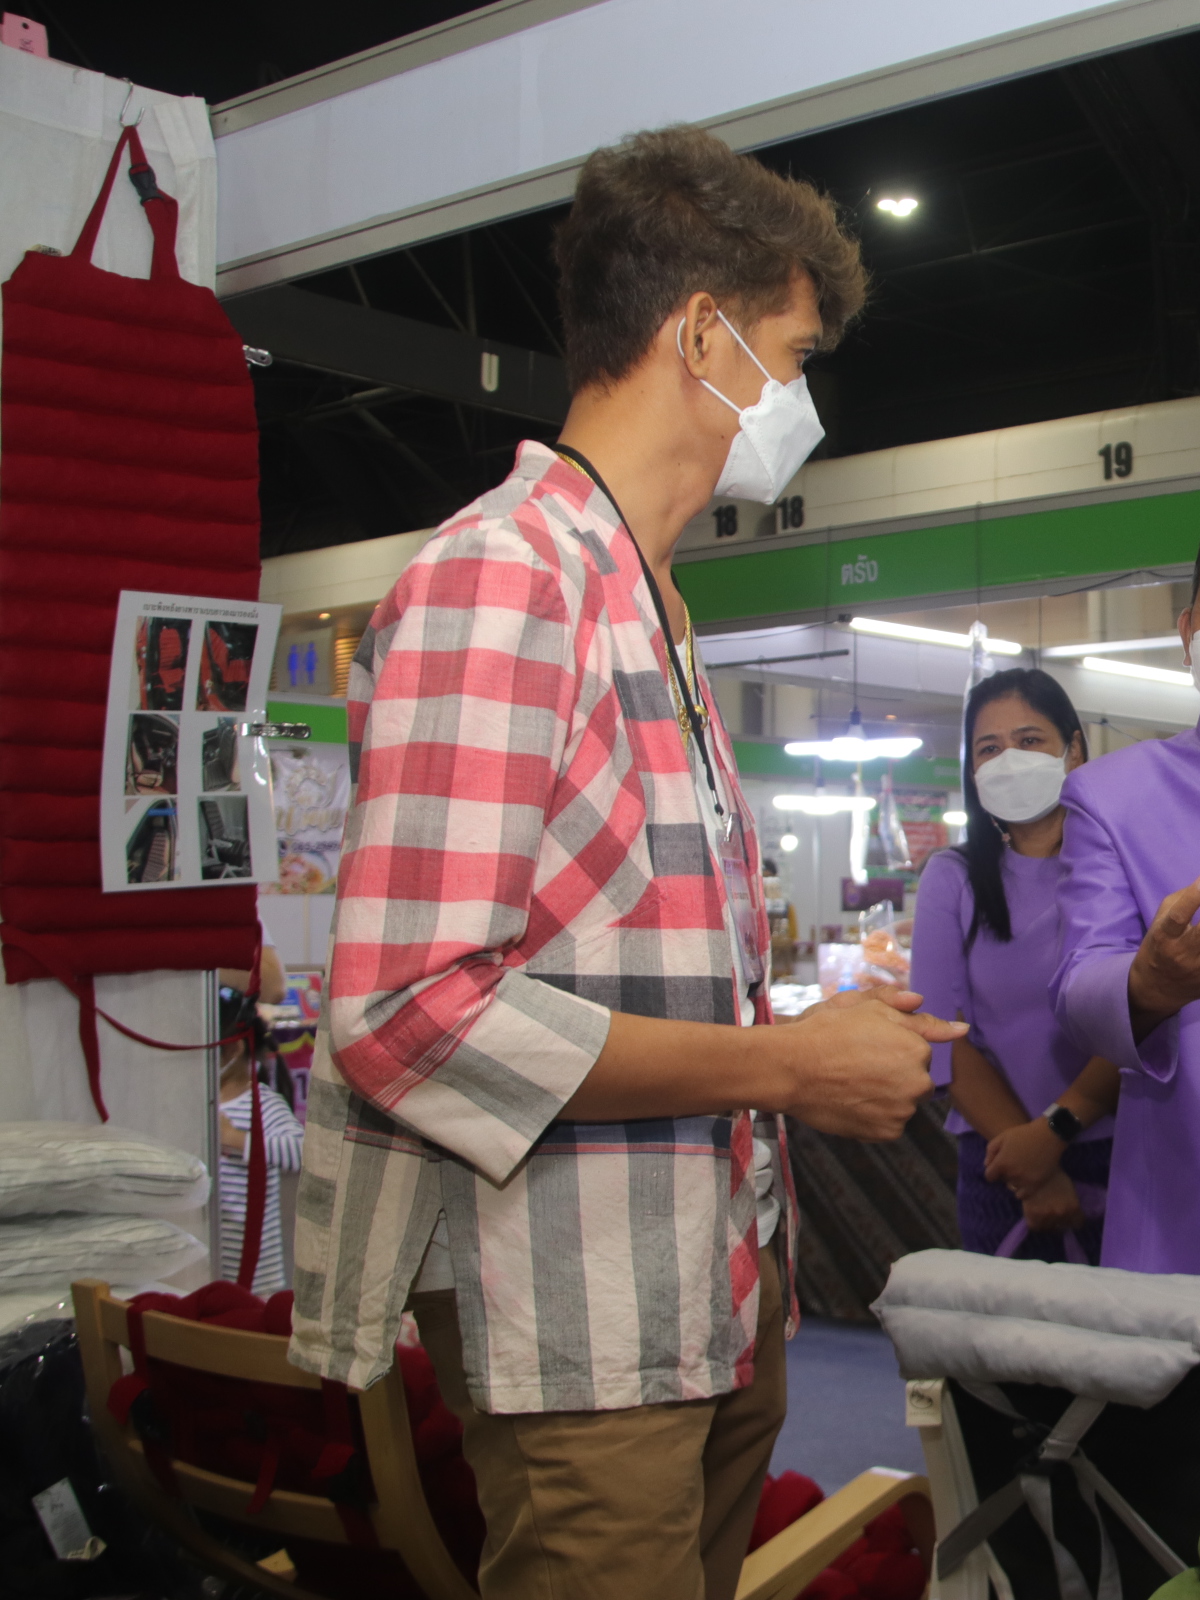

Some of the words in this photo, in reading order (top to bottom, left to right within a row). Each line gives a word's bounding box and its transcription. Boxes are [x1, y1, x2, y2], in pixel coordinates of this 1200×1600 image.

[1098, 441, 1133, 481] 19
[712, 504, 738, 538] 18
[777, 495, 804, 530] 18
[841, 554, 878, 586] ตรัง
